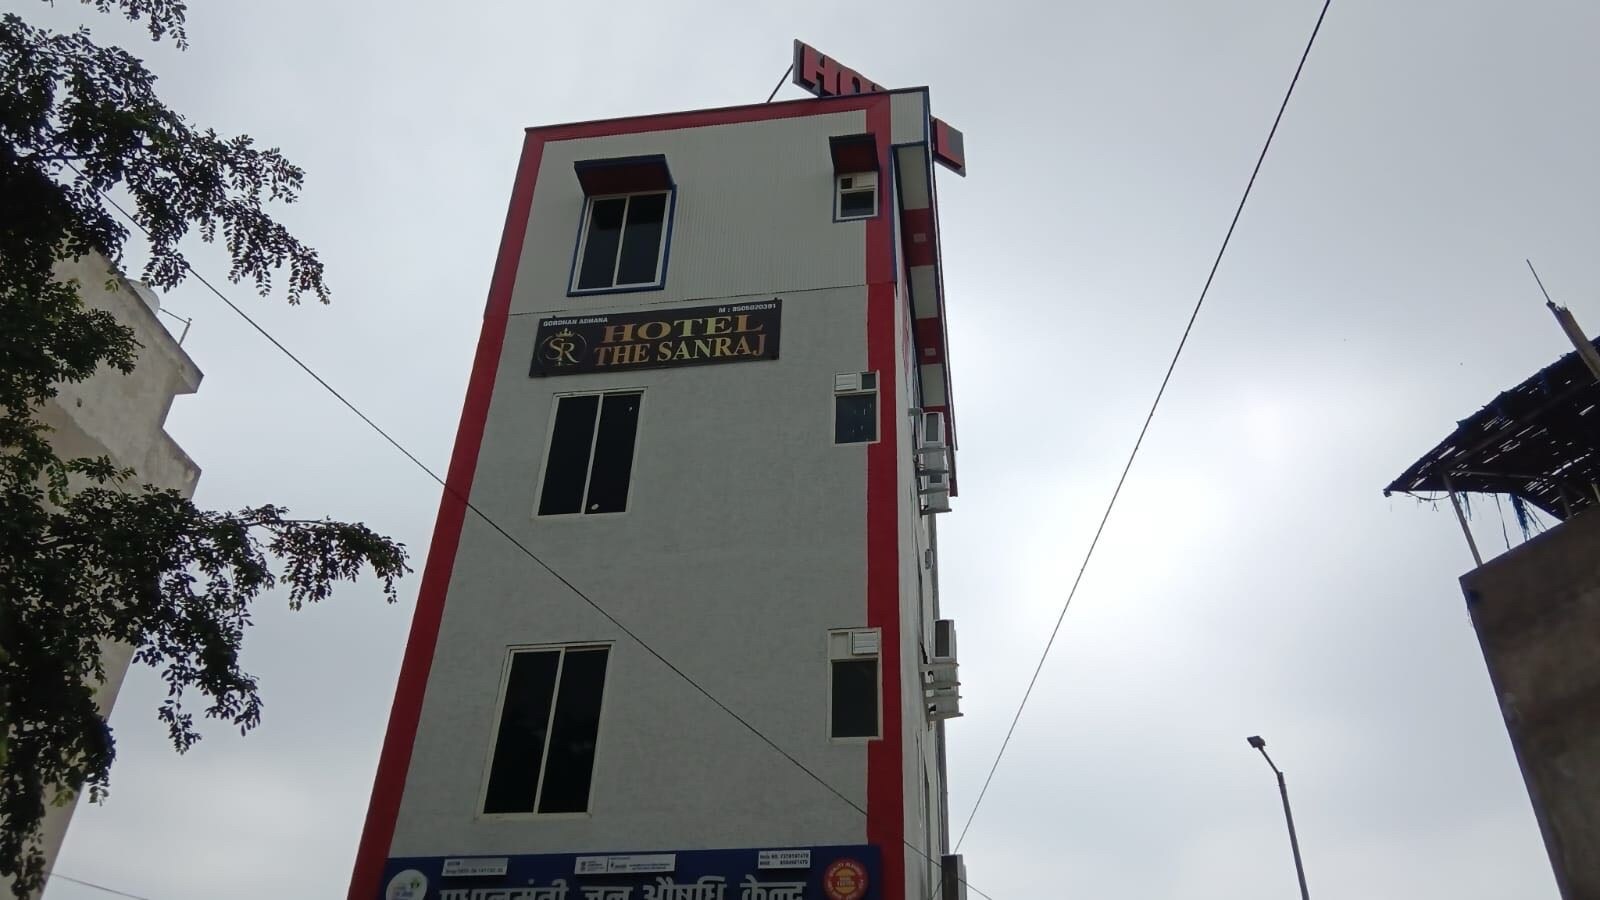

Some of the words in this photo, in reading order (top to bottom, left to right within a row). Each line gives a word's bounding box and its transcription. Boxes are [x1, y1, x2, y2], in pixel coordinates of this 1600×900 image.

[601, 314, 764, 344] HOTEL
[593, 343, 652, 367] THE
[656, 334, 768, 363] SANRAJ
